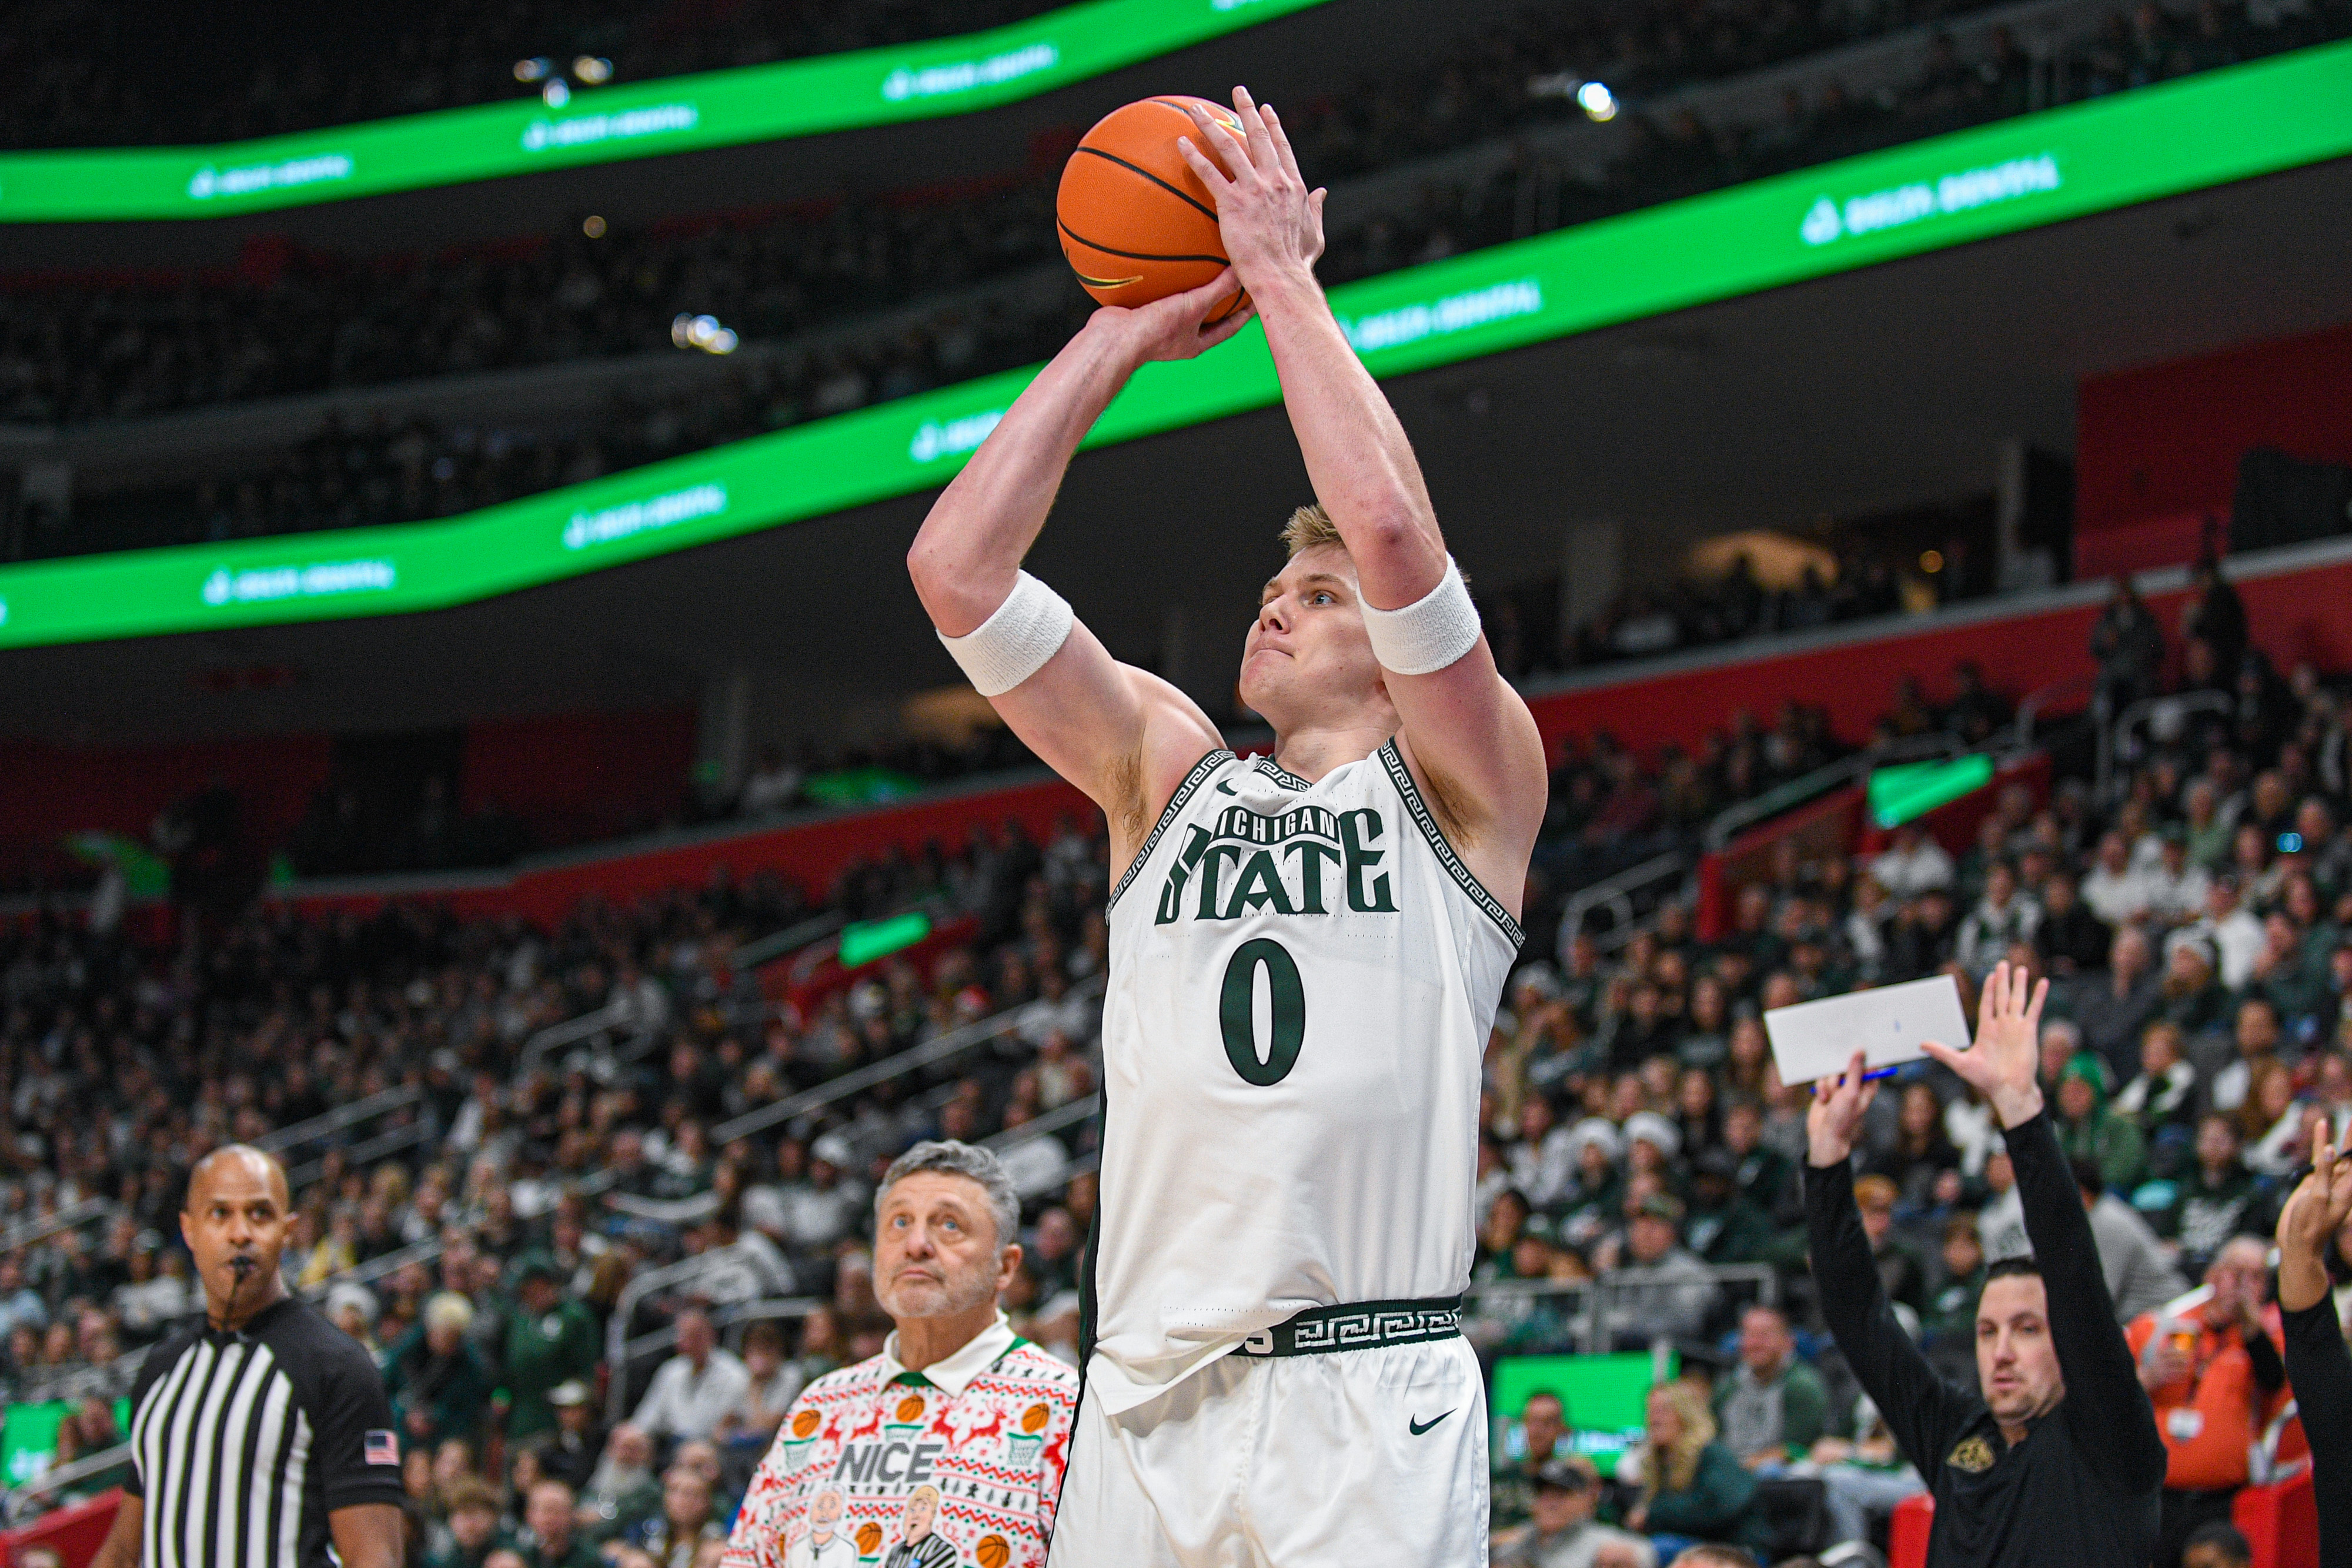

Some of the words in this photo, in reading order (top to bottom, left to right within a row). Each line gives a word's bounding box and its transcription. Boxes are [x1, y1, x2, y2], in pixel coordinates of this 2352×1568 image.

[1217, 807, 1338, 844] ICHIGAN
[1154, 808, 1401, 926] STATE
[1219, 937, 1306, 1087] 0
[833, 1442, 944, 1483] NICE
